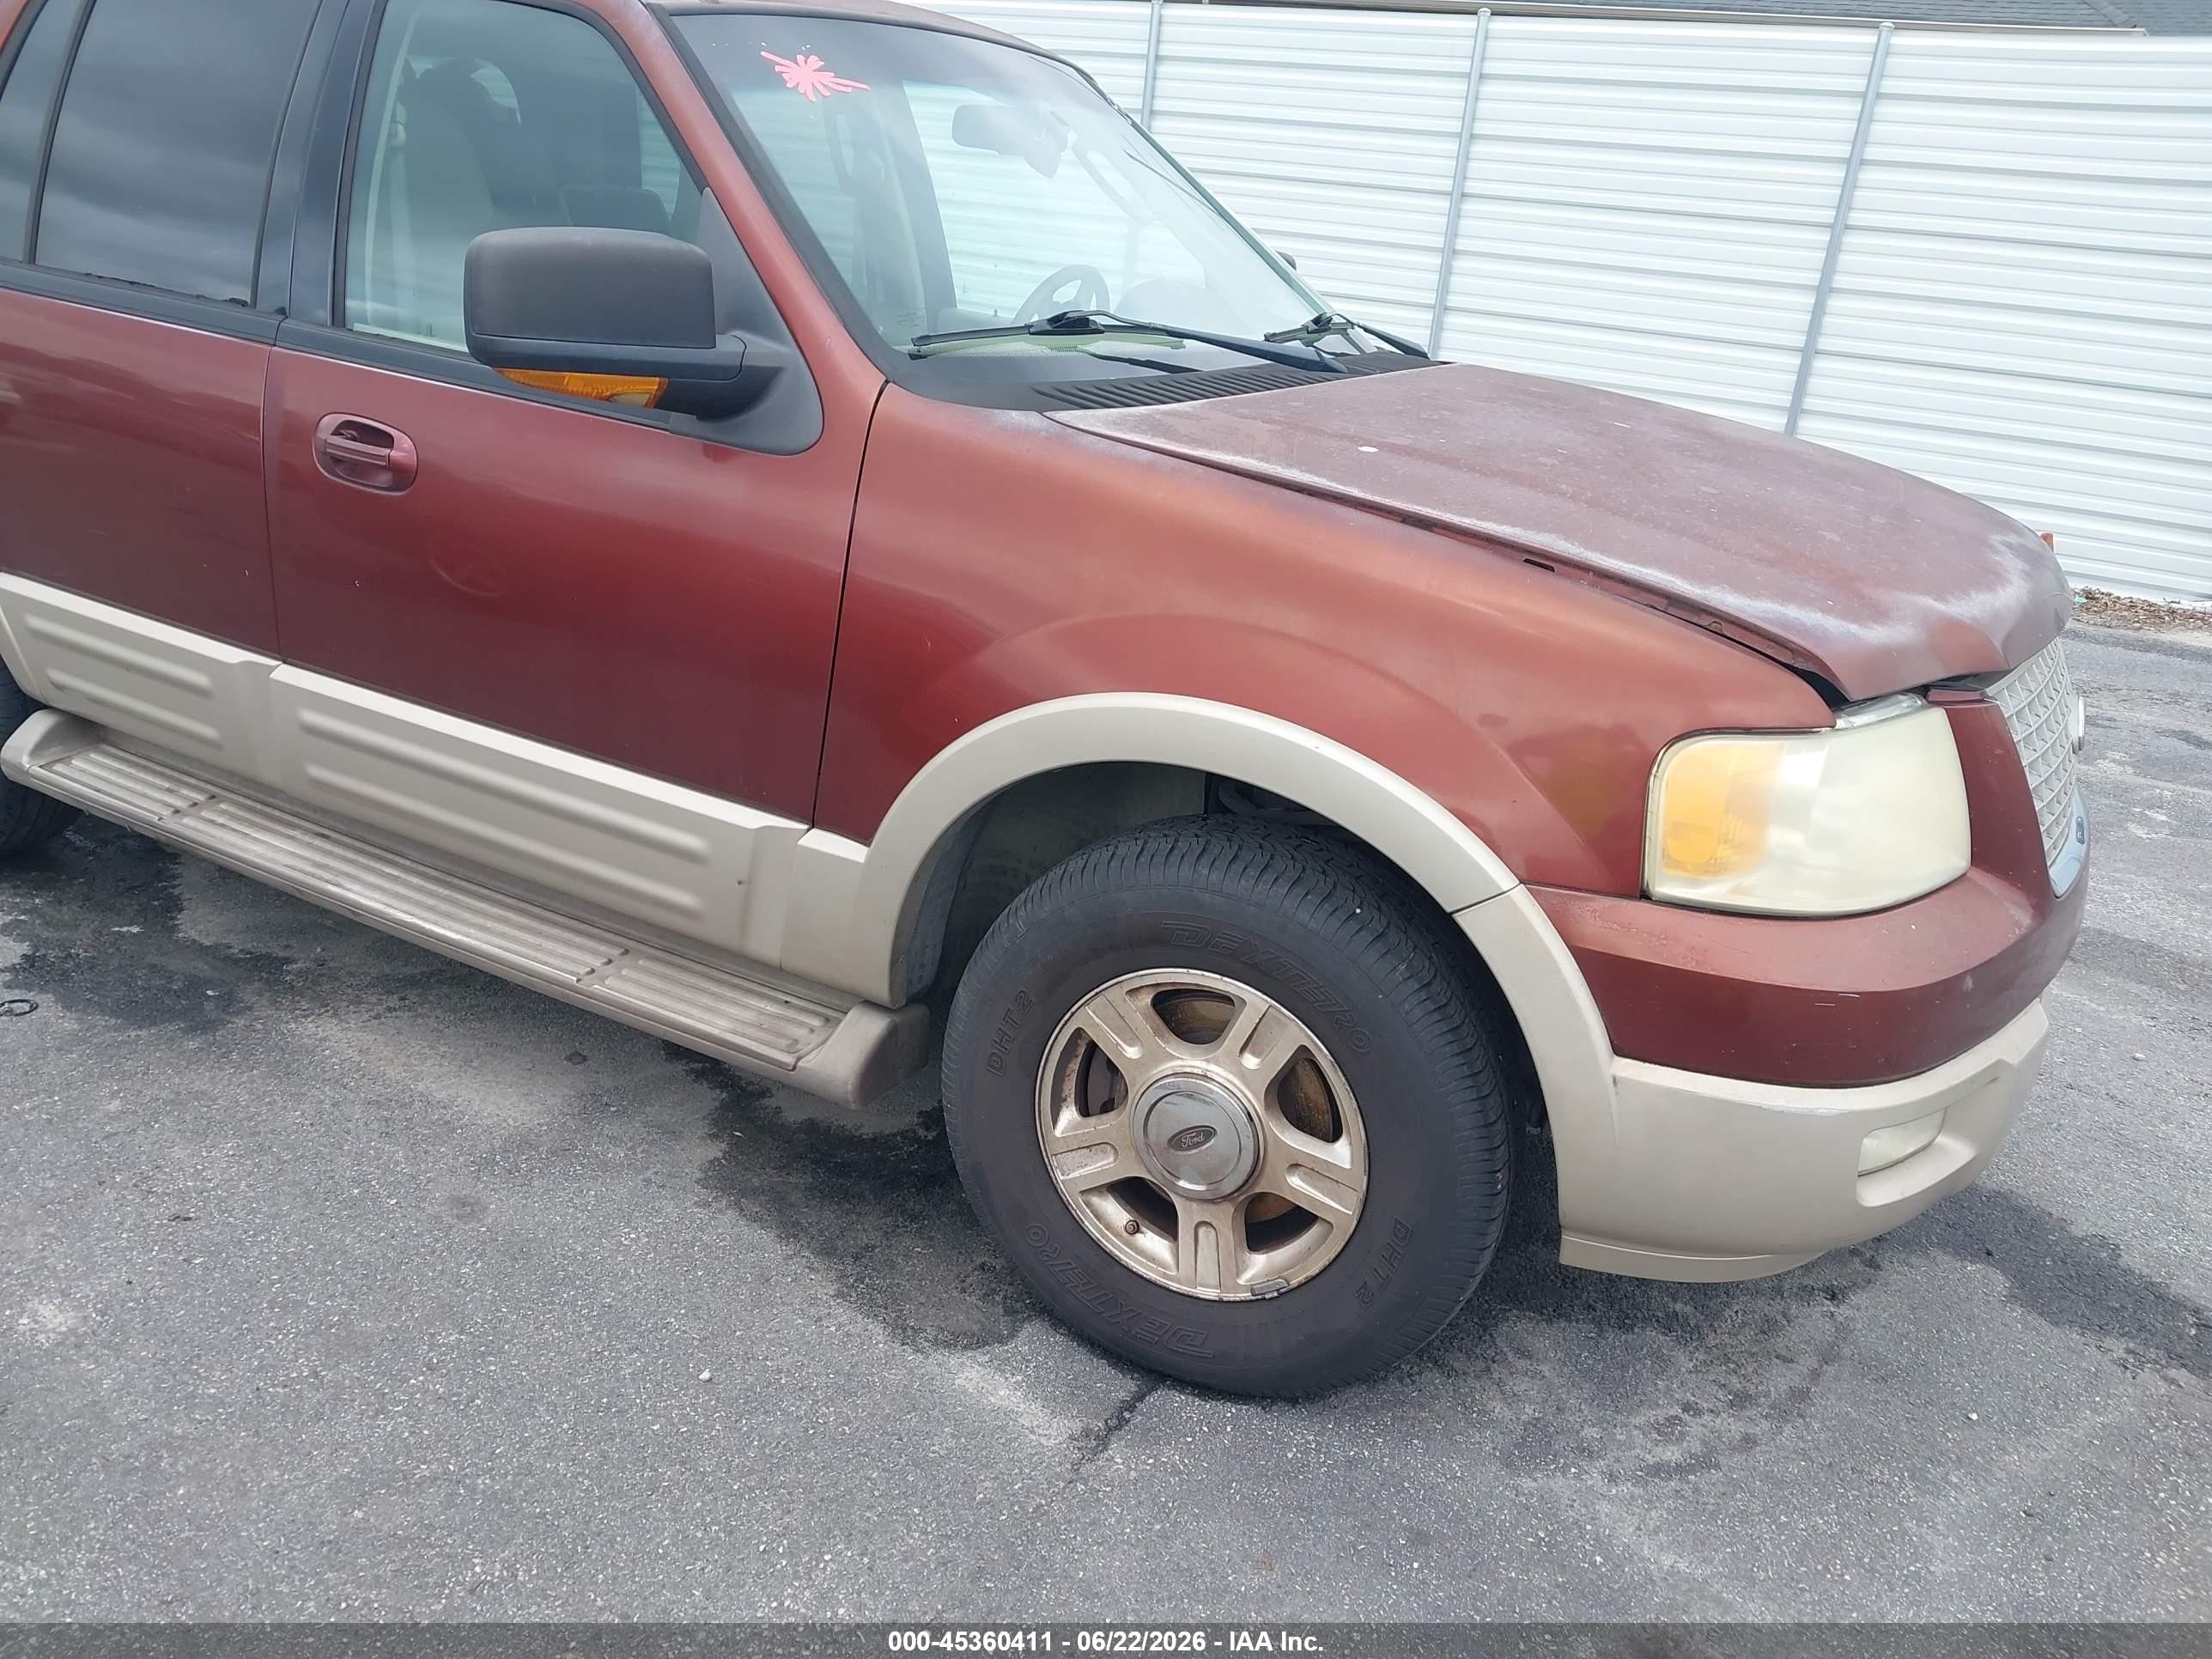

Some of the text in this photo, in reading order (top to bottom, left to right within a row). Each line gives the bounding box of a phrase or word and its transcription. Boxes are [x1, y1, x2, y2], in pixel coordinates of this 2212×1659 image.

[1160, 920, 1372, 1054] DEXTERO
[1181, 1131, 1206, 1148] Ford
[1024, 1223, 1215, 1358] DEXTERO
